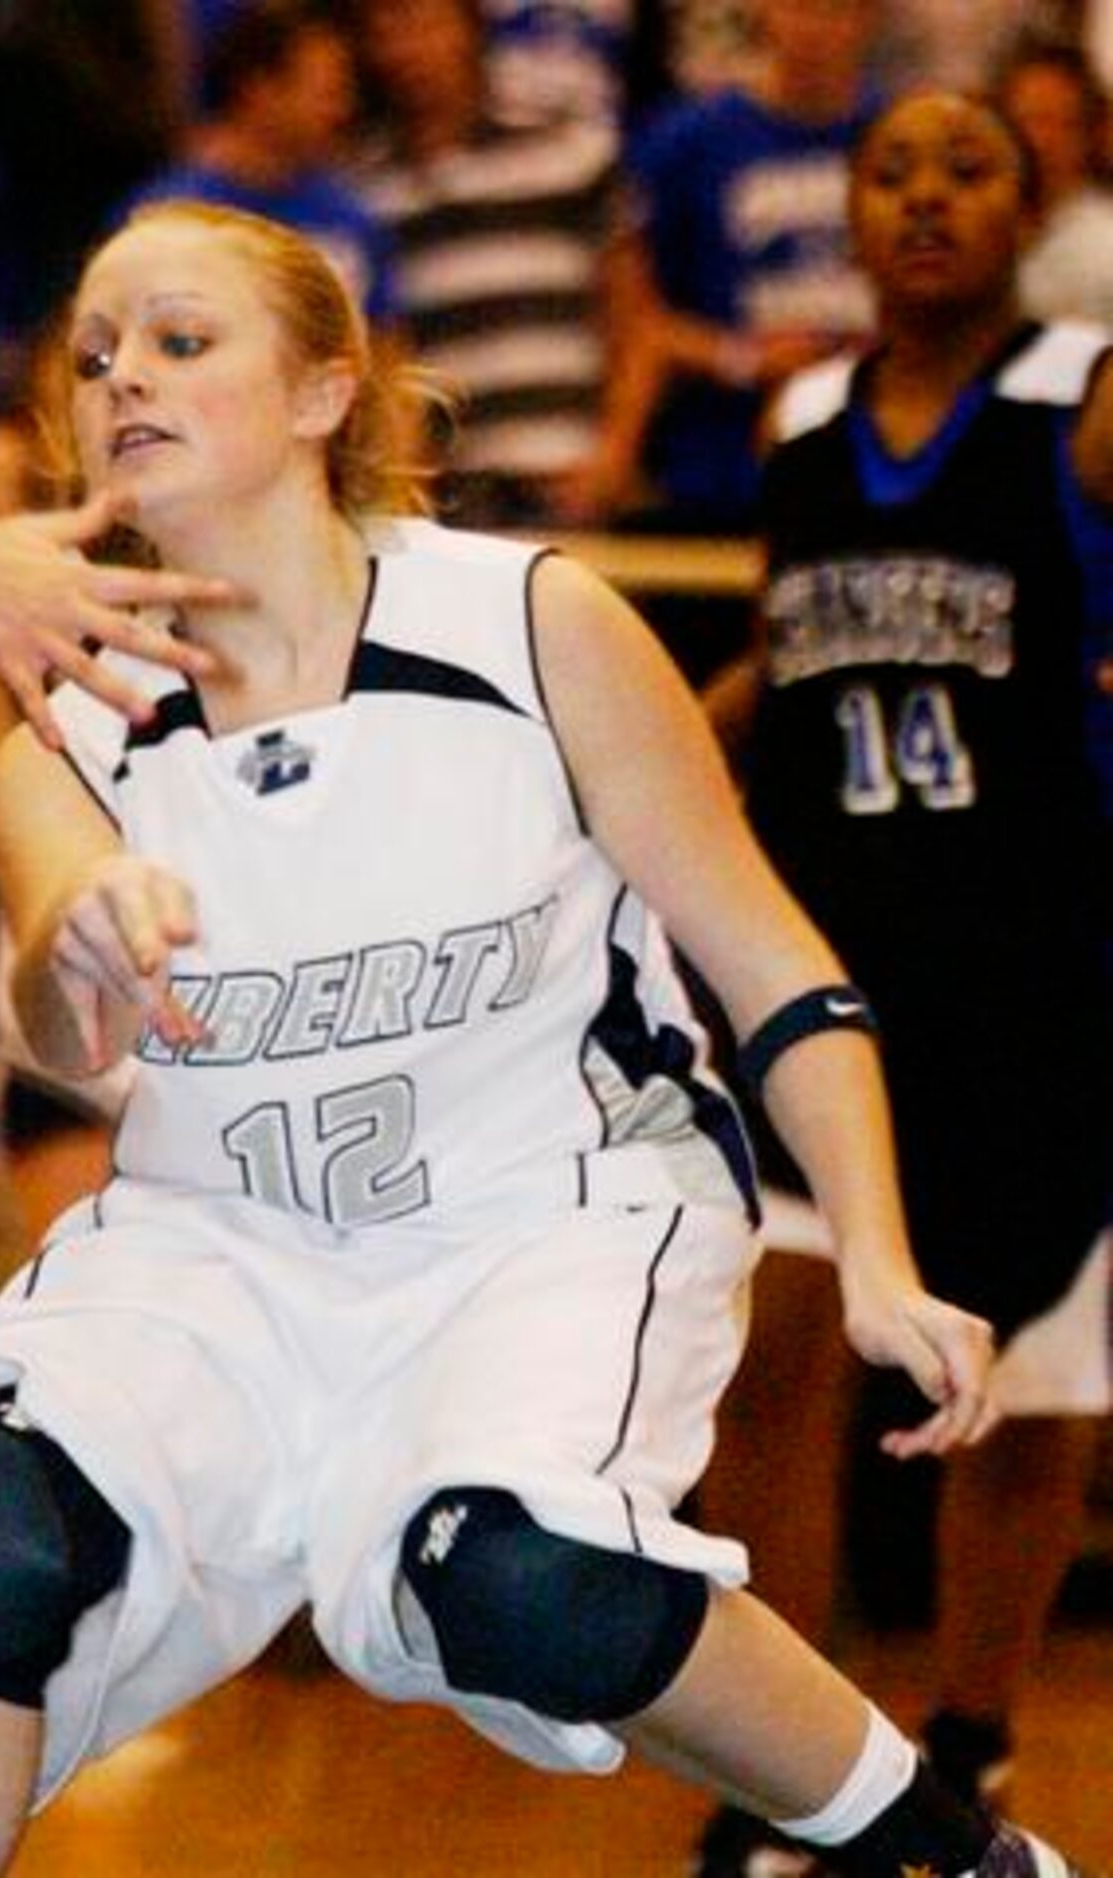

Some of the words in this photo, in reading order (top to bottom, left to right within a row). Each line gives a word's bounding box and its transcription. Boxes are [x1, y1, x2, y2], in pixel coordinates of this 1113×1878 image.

[835, 683, 976, 815] 14
[139, 893, 559, 1067] IBERTY
[222, 1073, 432, 1226] 12
